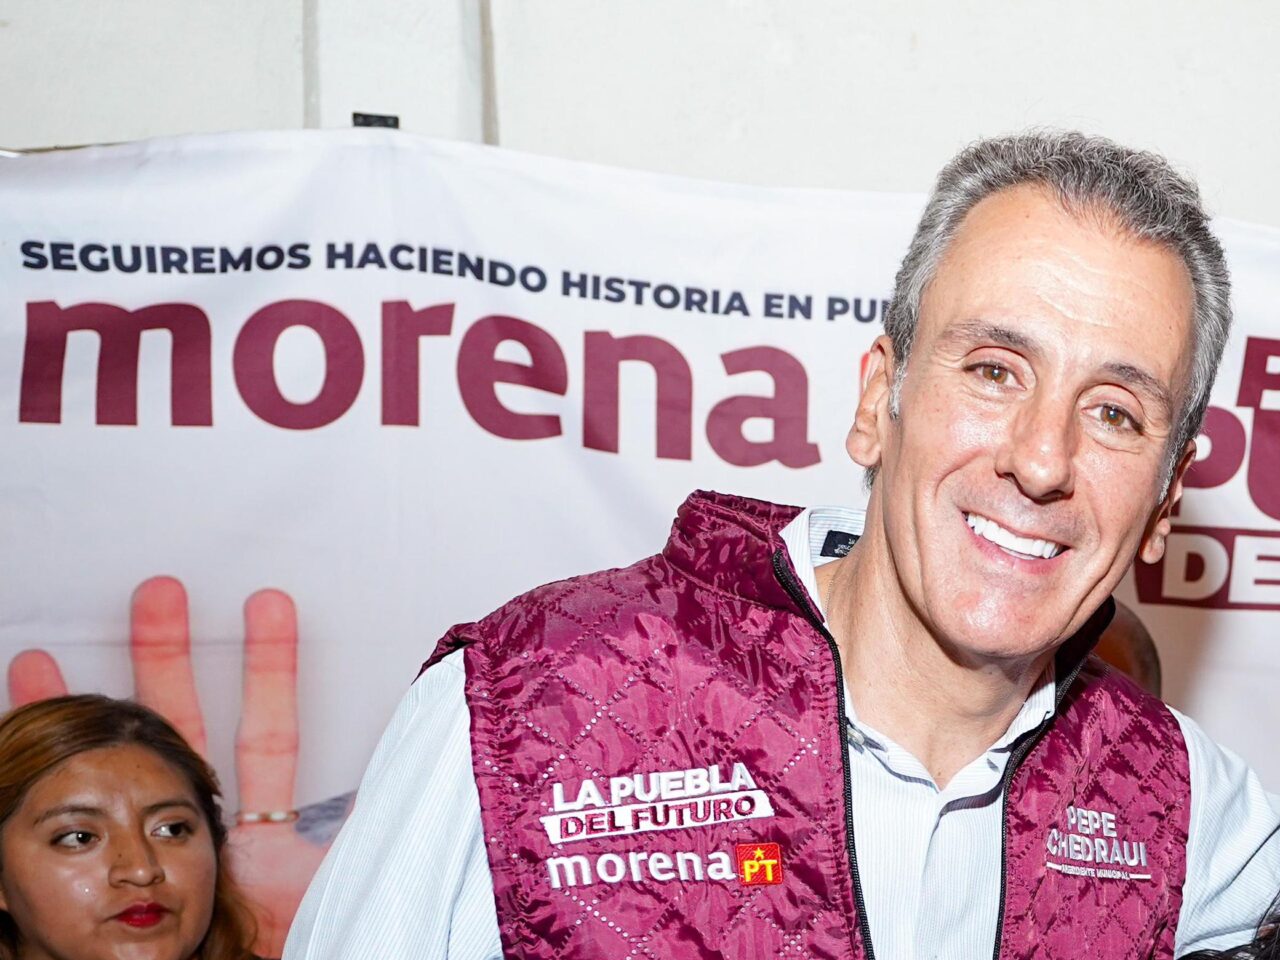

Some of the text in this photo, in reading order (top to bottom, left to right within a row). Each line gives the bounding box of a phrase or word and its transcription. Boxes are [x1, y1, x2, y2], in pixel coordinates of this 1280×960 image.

[20, 240, 312, 274] SEGUIREMOS
[325, 241, 547, 293] HACIENDO
[561, 270, 750, 317] HISTORIA
[763, 293, 813, 320] EN
[18, 298, 822, 470] morena
[553, 762, 758, 812] LA PUEBLA
[560, 795, 756, 839] DEL FUTURO
[1066, 805, 1117, 837] PEPE
[1046, 828, 1148, 867] CHEDRAUI
[546, 850, 737, 889] morena
[743, 859, 778, 882] PT
